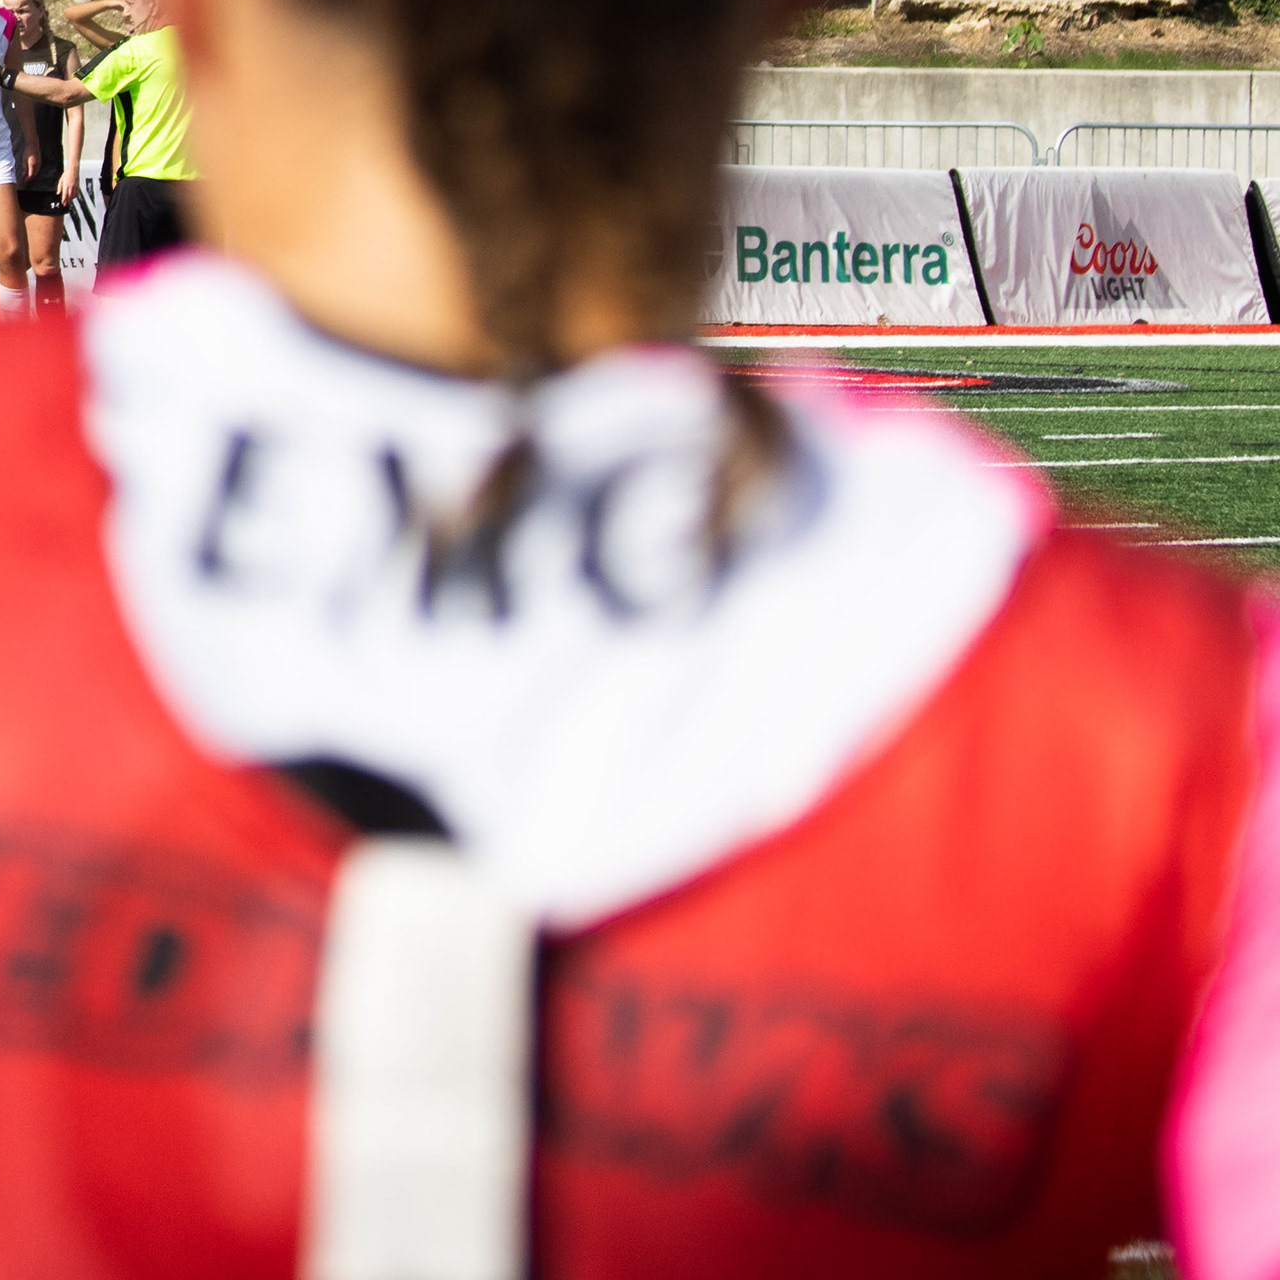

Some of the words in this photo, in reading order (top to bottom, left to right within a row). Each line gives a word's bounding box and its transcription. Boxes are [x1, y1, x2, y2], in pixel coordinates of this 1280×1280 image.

[737, 226, 949, 286] Banterra
[1070, 223, 1158, 275] Coors
[1091, 277, 1145, 300] LIGHT
